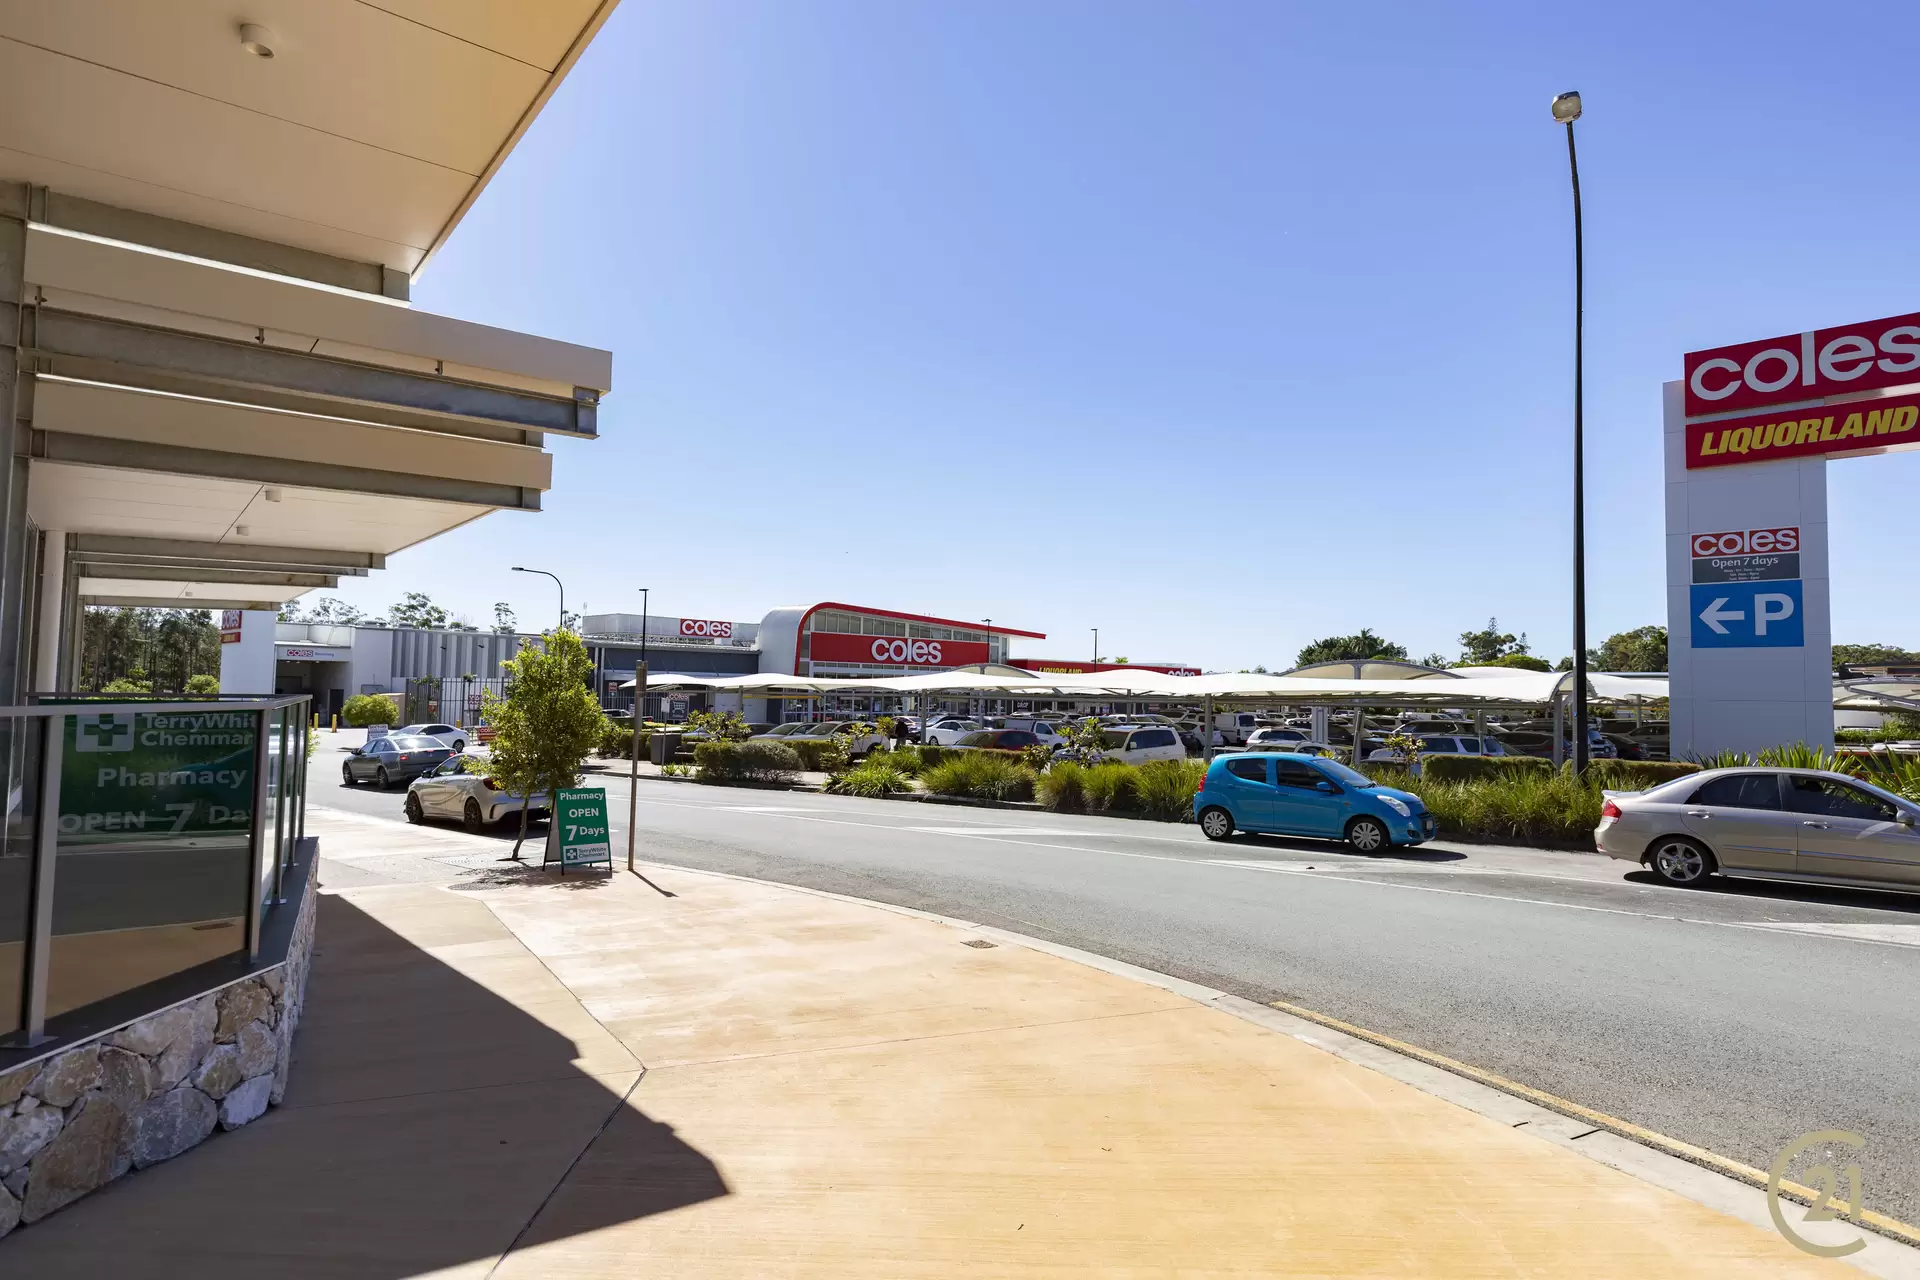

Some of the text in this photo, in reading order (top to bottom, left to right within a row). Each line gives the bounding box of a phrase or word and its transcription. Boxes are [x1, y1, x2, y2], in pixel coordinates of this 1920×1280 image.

[1690, 326, 1920, 401] coles
[1700, 405, 1919, 456] LIQUORLAND
[1694, 530, 1797, 556] coles
[1711, 556, 1779, 569] Open 7 days
[1754, 593, 1794, 635] P
[681, 619, 732, 637] coles
[288, 649, 313, 657] coles
[871, 638, 942, 664] coles
[141, 713, 256, 732] TerryWhit
[140, 730, 254, 747] Chemmar
[97, 766, 248, 789] Pharmacy
[560, 792, 604, 800] Pharmacy
[58, 810, 145, 833] OPEN
[165, 803, 196, 836] 7
[569, 808, 599, 817] OPEN
[565, 825, 605, 841] 7 Days
